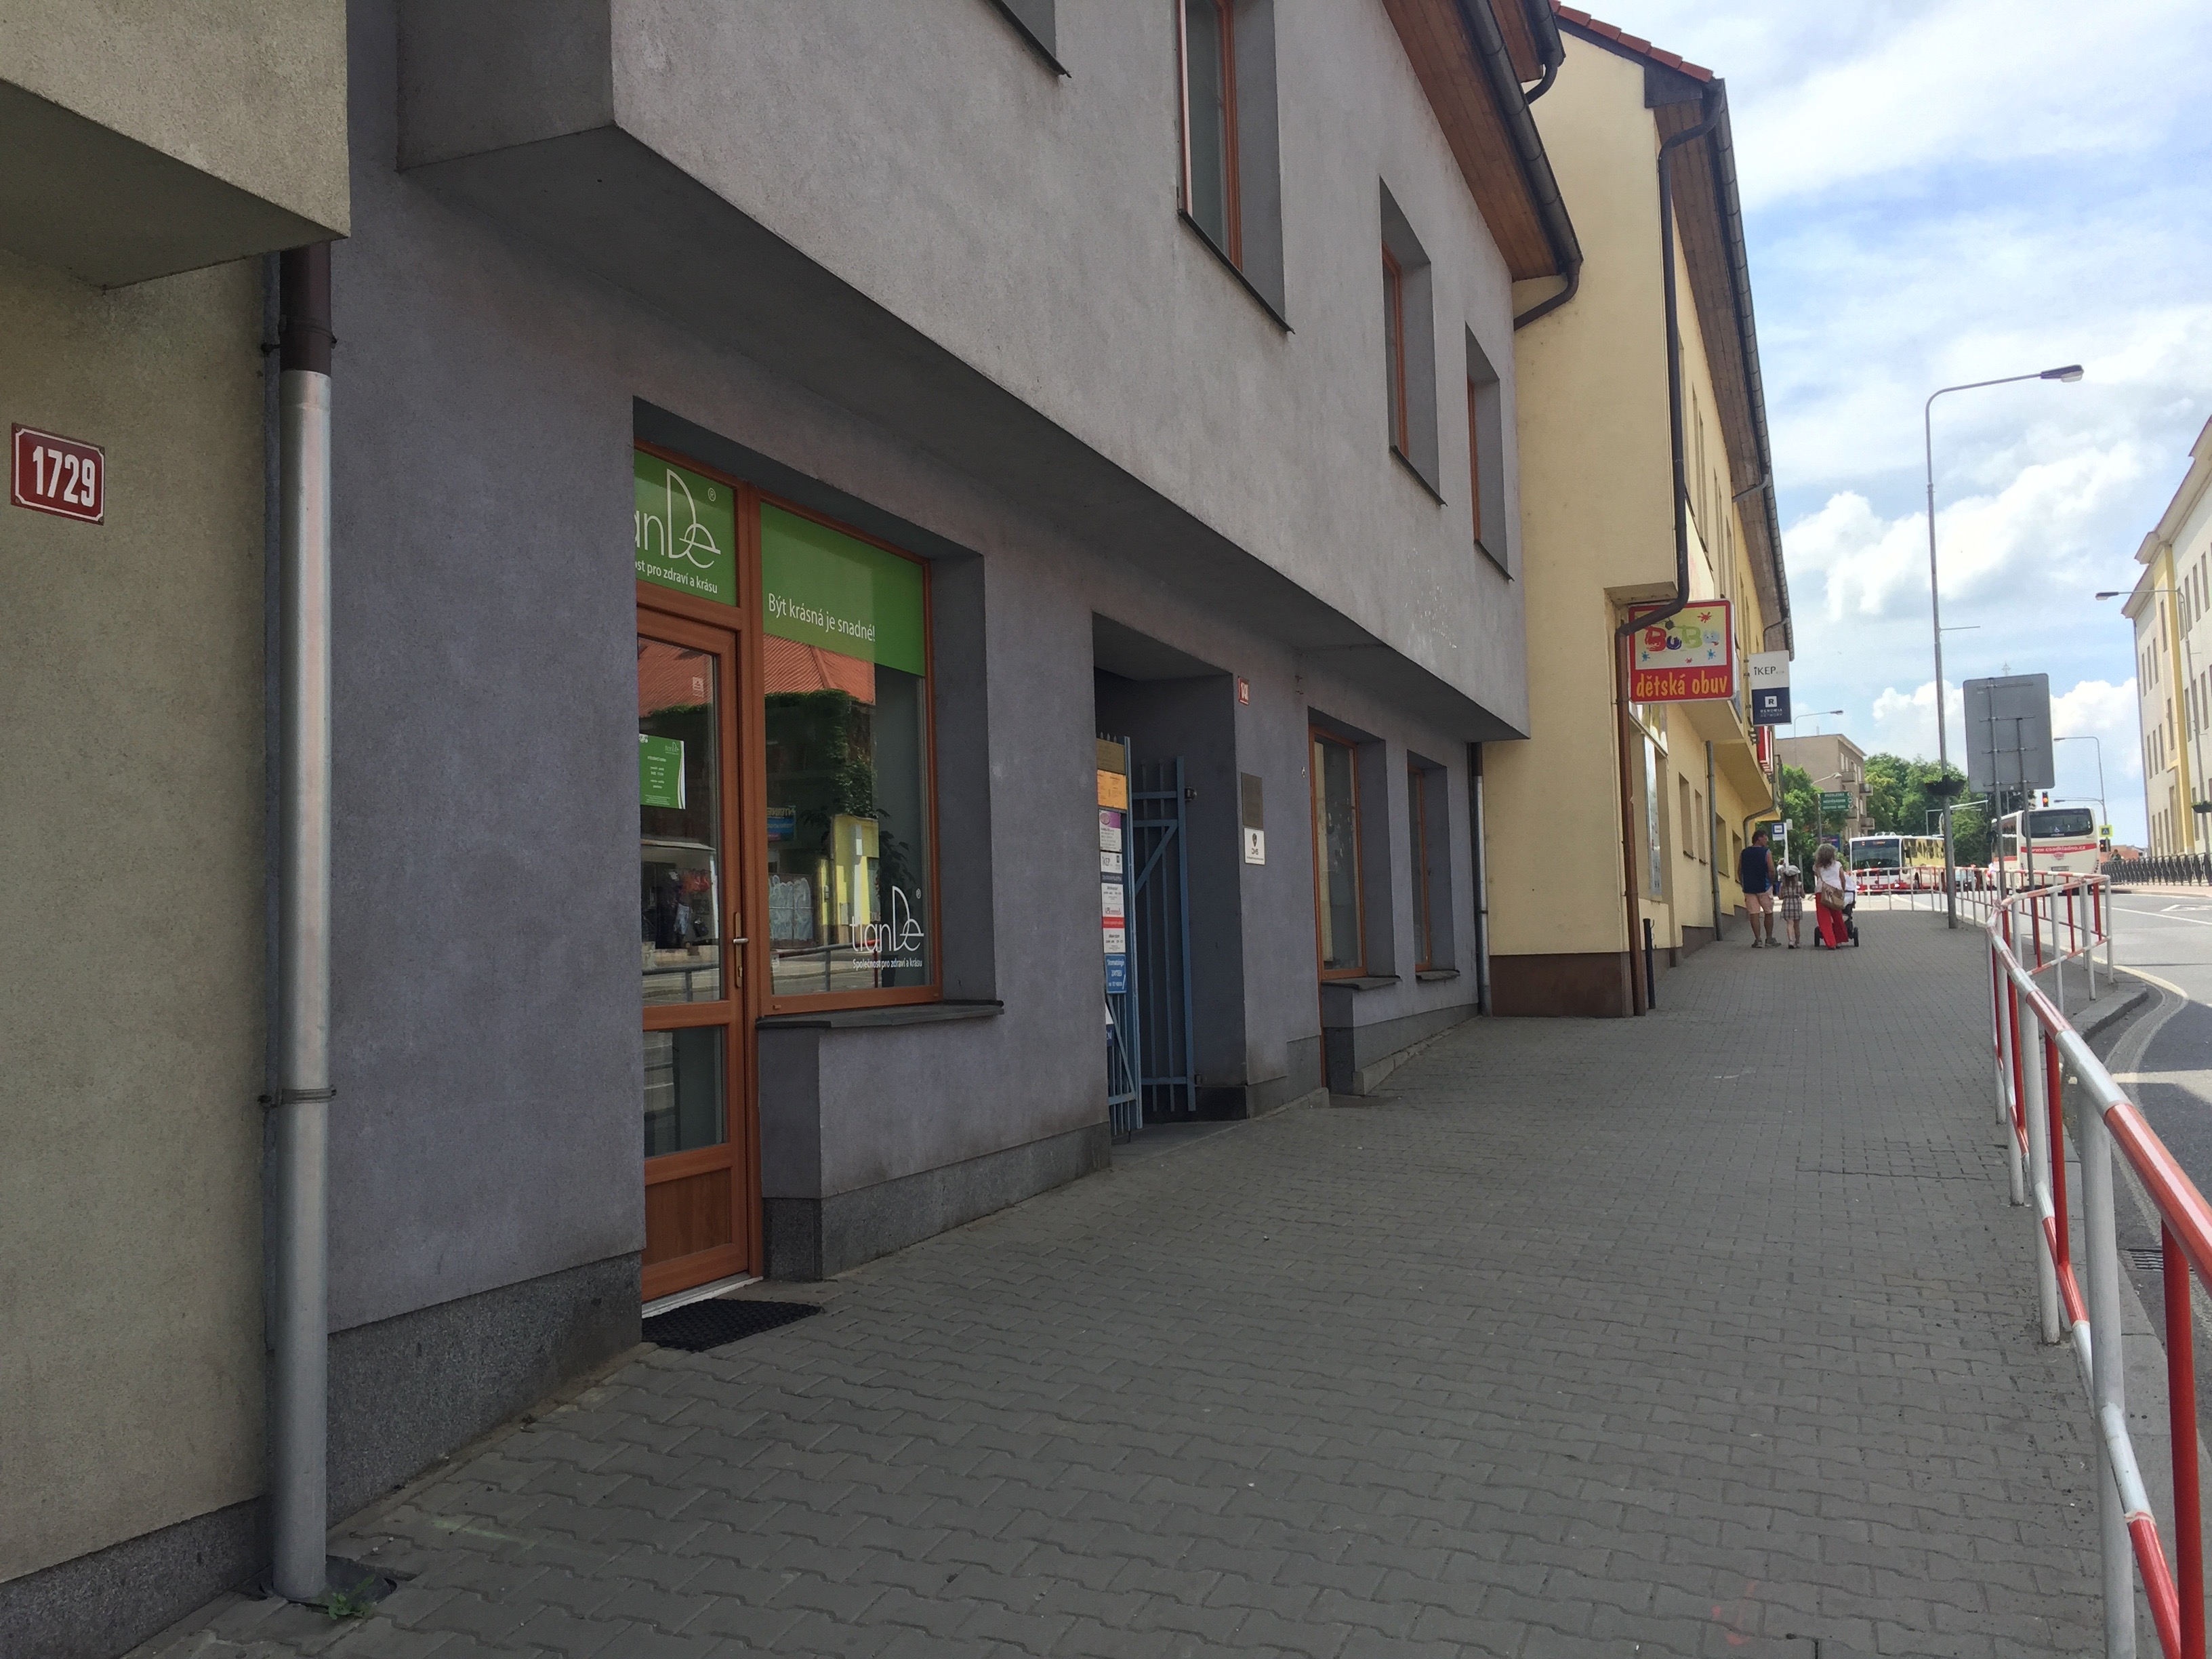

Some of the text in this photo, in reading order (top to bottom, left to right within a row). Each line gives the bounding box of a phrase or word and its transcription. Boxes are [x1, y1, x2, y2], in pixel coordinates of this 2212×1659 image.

[33, 445, 96, 508] 1729
[647, 563, 661, 576] pro
[663, 567, 689, 585] zdraví
[689, 576, 695, 587] a
[696, 575, 718, 594] krásu
[769, 593, 876, 642] Být krásná je snadné!
[1636, 670, 1727, 698] dětská obuv
[849, 885, 924, 954] tianDe
[853, 958, 923, 970] Společnost pro zdraví a krásu
